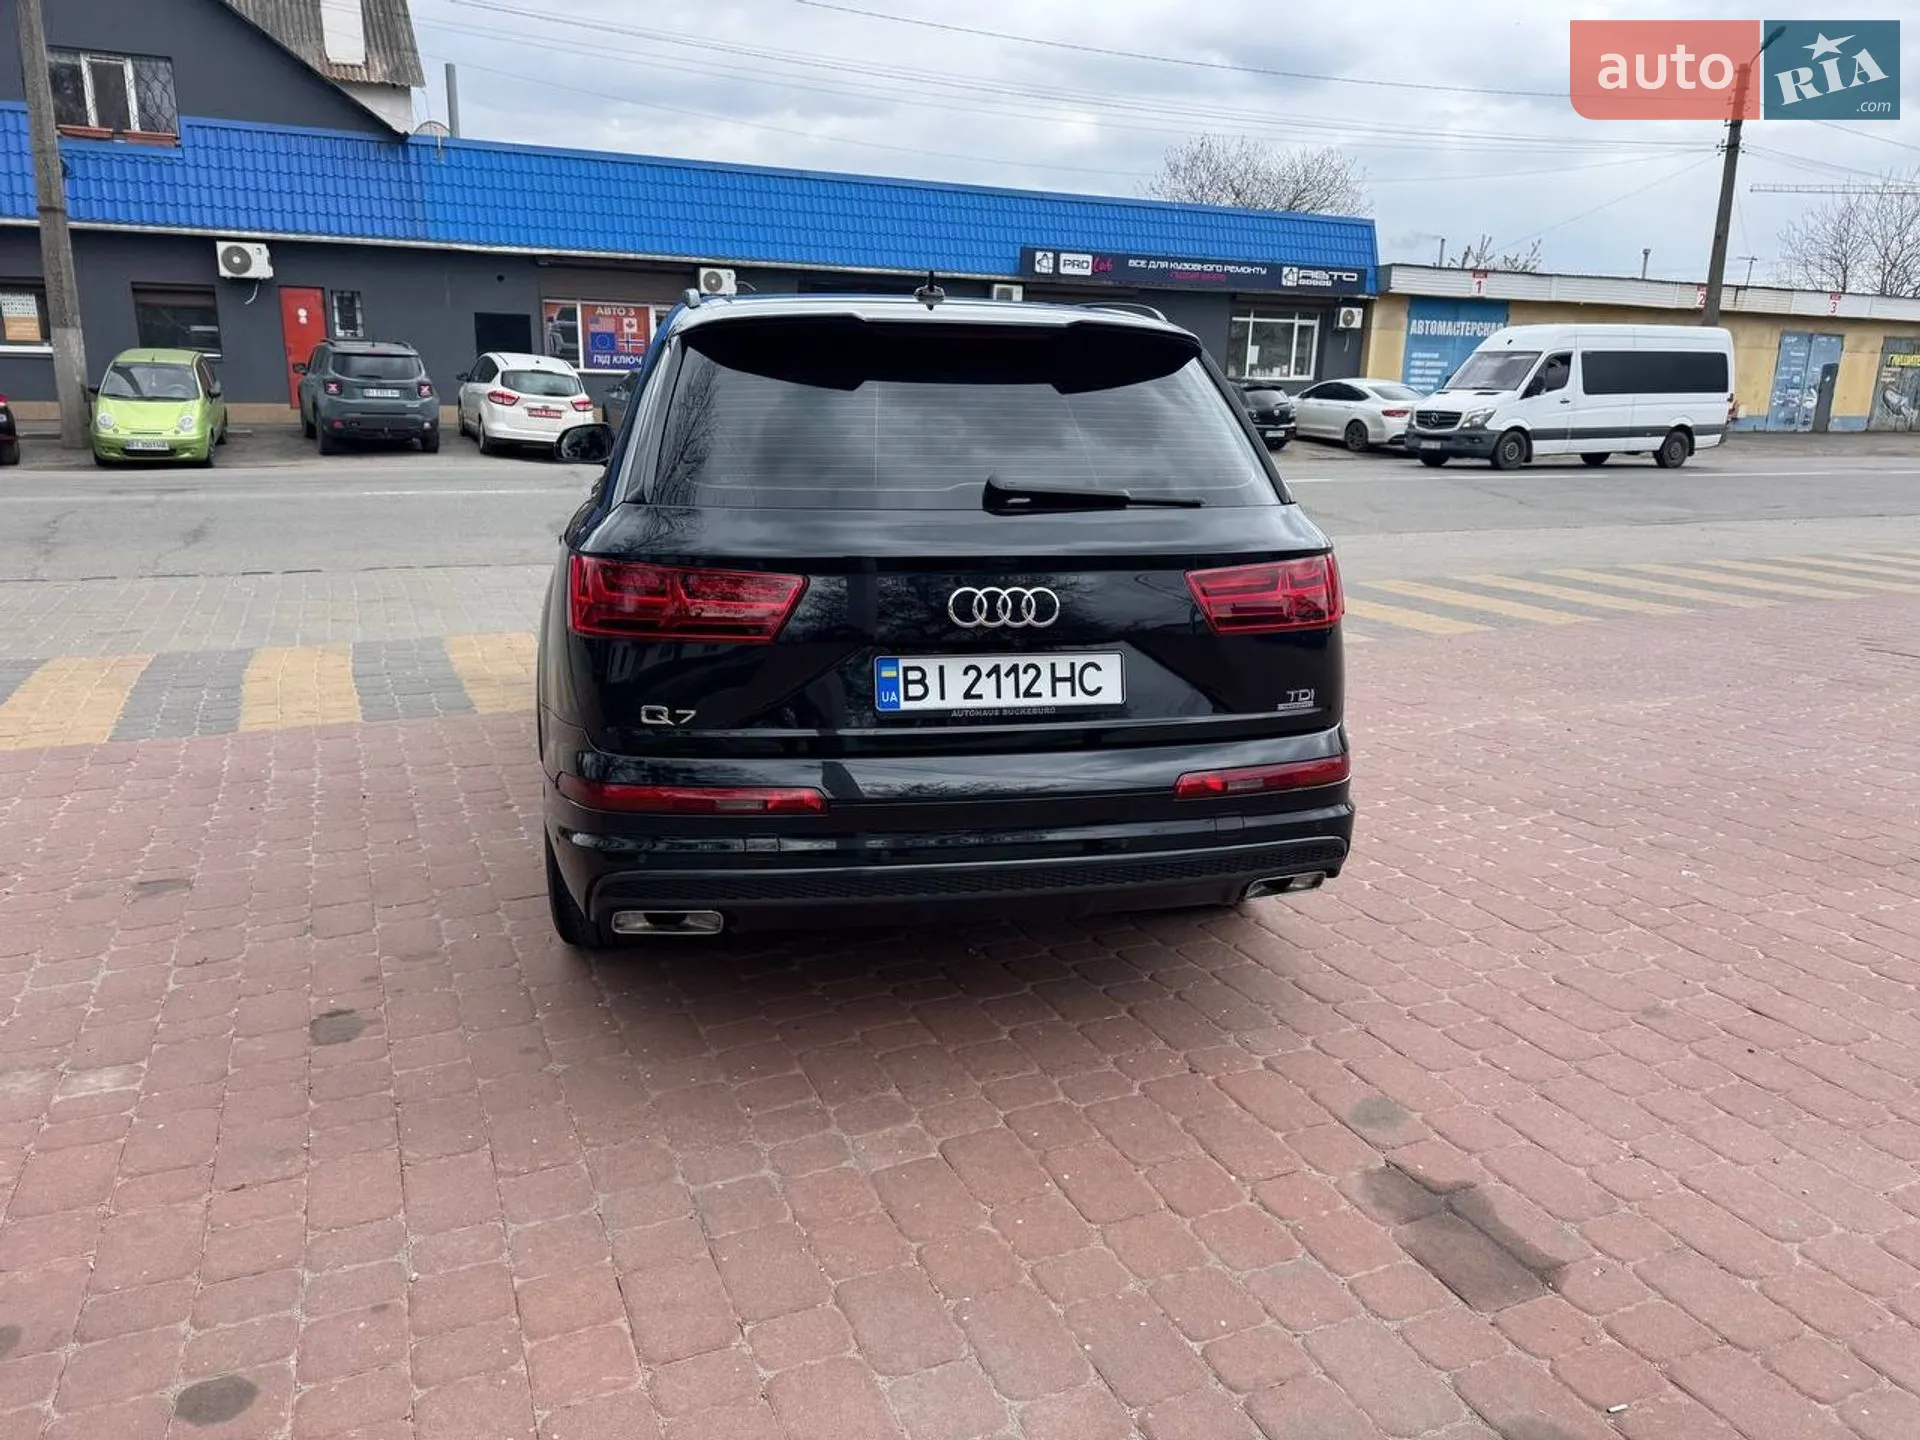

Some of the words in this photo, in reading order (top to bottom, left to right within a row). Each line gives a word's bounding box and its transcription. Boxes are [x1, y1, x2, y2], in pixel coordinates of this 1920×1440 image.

[1063, 259, 1090, 269] PRO
[1127, 259, 1147, 268] ВСЕ
[1147, 260, 1169, 270] ДЛЯ
[1169, 262, 1222, 273] КУЗОВНОГО
[1223, 265, 1267, 275] РЕМОНТУ
[594, 306, 626, 317] АВТО
[593, 354, 611, 365] ПІД
[613, 355, 643, 365] КЛЮЧ
[902, 665, 946, 701] BI
[881, 692, 898, 702] UA
[1286, 688, 1315, 702] TDI
[640, 704, 697, 726] Q7
[951, 708, 1000, 717] AUTOHAUS
